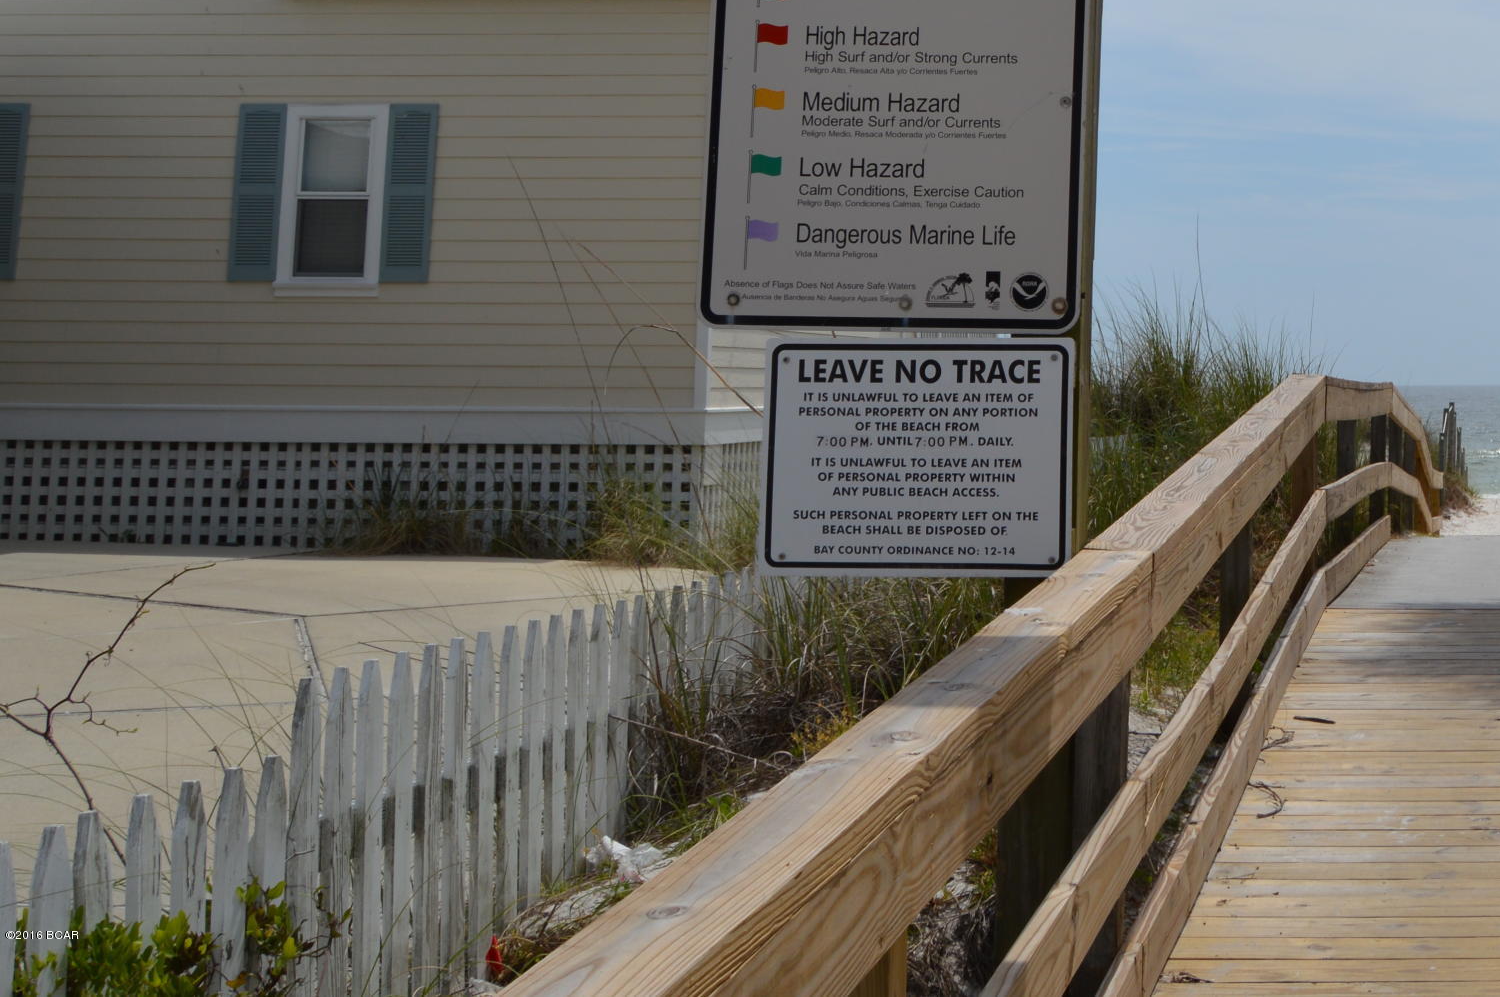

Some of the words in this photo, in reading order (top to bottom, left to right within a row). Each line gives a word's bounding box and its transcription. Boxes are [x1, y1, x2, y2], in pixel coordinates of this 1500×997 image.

[805, 24, 845, 50] High
[852, 25, 919, 46] Hazard
[804, 49, 833, 65] High
[837, 50, 866, 63] Surf
[913, 50, 957, 66] Strong
[961, 51, 1018, 64] Currents
[802, 90, 879, 112] Medium
[887, 92, 960, 113] Hazard
[801, 114, 864, 127] Moderate
[867, 114, 896, 127] Surf
[944, 115, 1001, 128] Currents
[799, 156, 842, 177] Low
[849, 157, 925, 178] Hazard
[798, 183, 832, 196] Calm
[912, 184, 970, 198] Exercise
[973, 185, 1024, 198] Caution
[795, 222, 902, 249] Dangerous
[909, 223, 974, 245] Marine
[981, 224, 1016, 246] Life
[723, 278, 760, 288] Absence
[761, 279, 770, 288] of
[771, 279, 794, 290] Flags
[795, 280, 818, 289] Does
[819, 281, 834, 289] Not
[835, 280, 865, 290] Assure
[865, 280, 885, 290] Safe
[887, 281, 916, 290] Waters
[797, 358, 884, 383] LEAVE
[894, 358, 942, 384] NO
[951, 358, 1041, 384] TRACE
[803, 391, 814, 402] IT
[817, 391, 828, 402] IS
[832, 392, 898, 402] UNLAWFUL
[901, 392, 918, 402] TO
[922, 392, 958, 402] LEAVE
[961, 392, 981, 402] AN
[984, 392, 1013, 402] ITEM
[1016, 392, 1034, 403] OF
[798, 406, 861, 417] PERSONAL
[864, 406, 925, 417] PROPERTY
[928, 406, 948, 417] ON
[951, 406, 978, 417] ANY
[981, 407, 1038, 417] PORTION
[854, 421, 871, 431] OF
[874, 421, 897, 431] THE
[900, 421, 940, 431] BEACH
[944, 421, 979, 432] FROM
[813, 544, 834, 554] BAY
[837, 544, 883, 554] COUNTY
[886, 545, 954, 555] ORDINANCE
[984, 546, 1015, 555] 12-14
